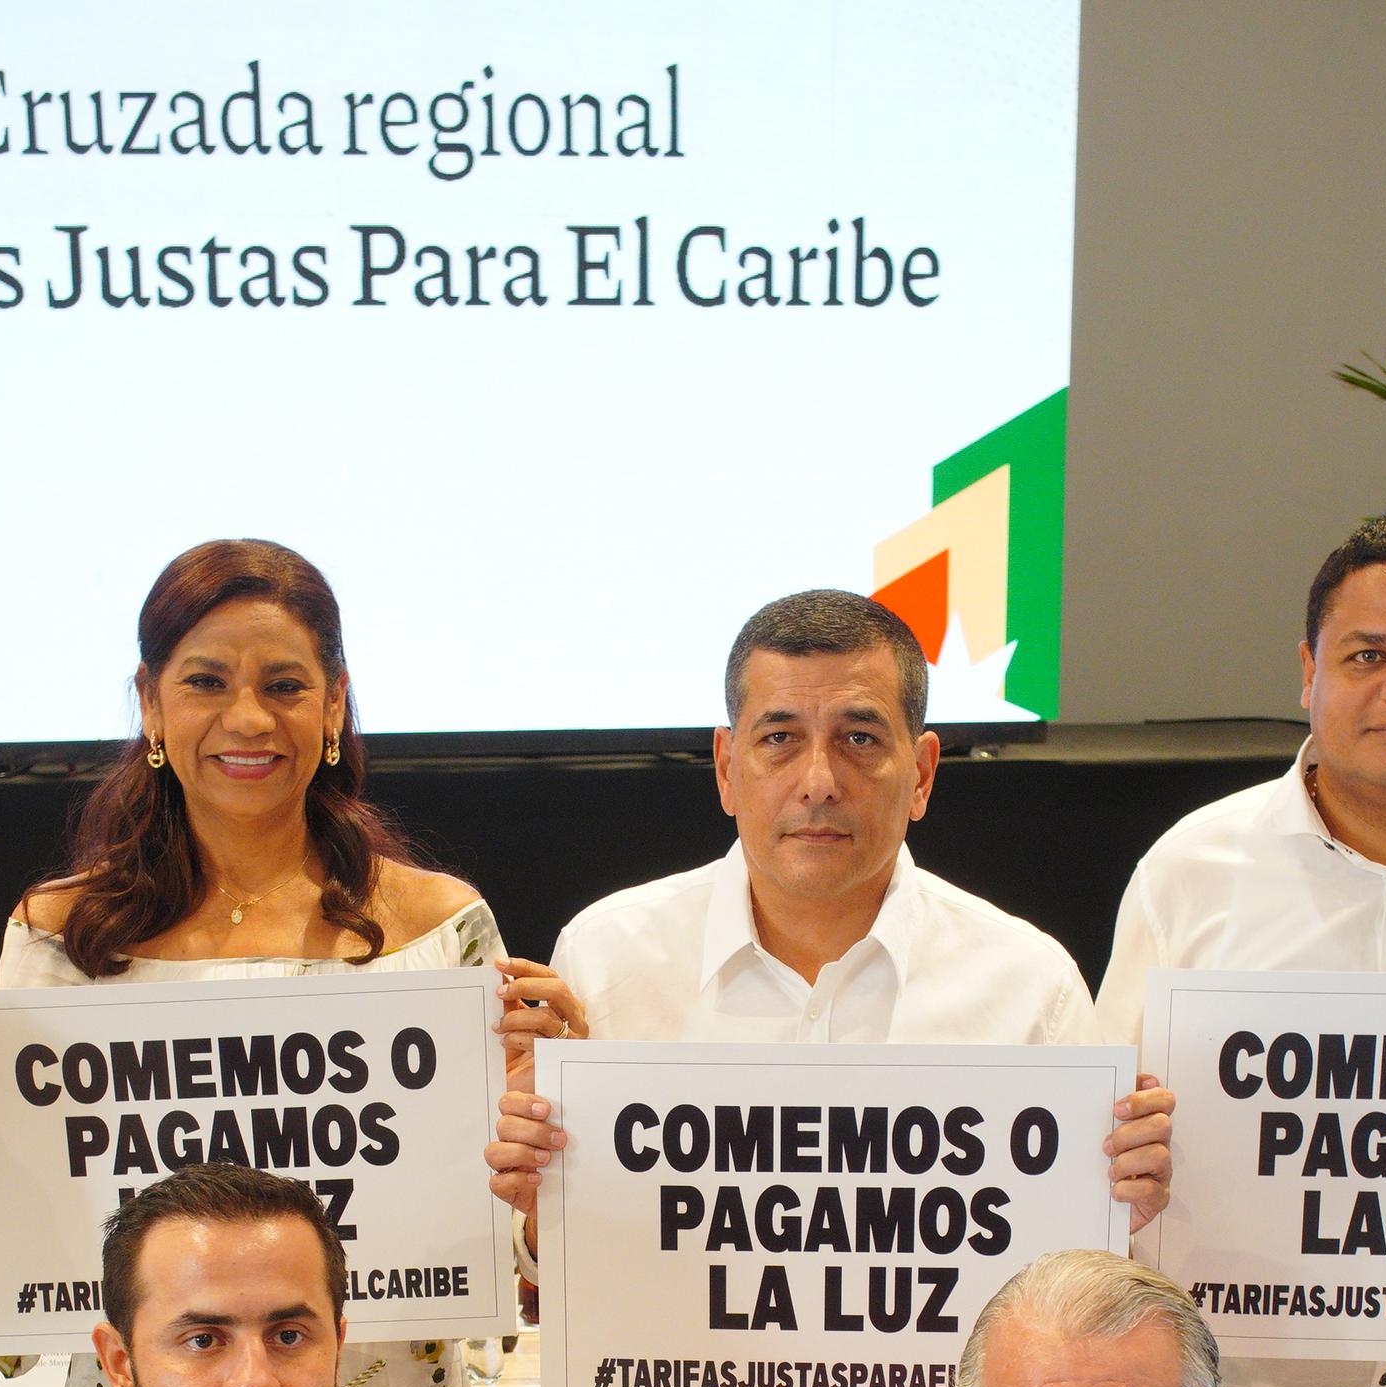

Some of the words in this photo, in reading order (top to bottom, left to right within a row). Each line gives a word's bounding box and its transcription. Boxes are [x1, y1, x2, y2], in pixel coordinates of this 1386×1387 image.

[343, 64, 684, 181] regional
[48, 226, 328, 309] Justas
[350, 225, 548, 307] Para
[566, 216, 654, 305] El
[677, 217, 939, 307] Caribe
[15, 1031, 368, 1106] COMEMOS
[391, 1027, 436, 1089] O
[65, 1102, 399, 1177] PAGAMOS
[614, 1103, 985, 1175] COMEMOS
[1010, 1107, 1058, 1175] O
[661, 1185, 1011, 1256] PAGAMOS
[1301, 1191, 1386, 1255] LA
[710, 1265, 798, 1330] LA
[824, 1266, 958, 1333] LUZ
